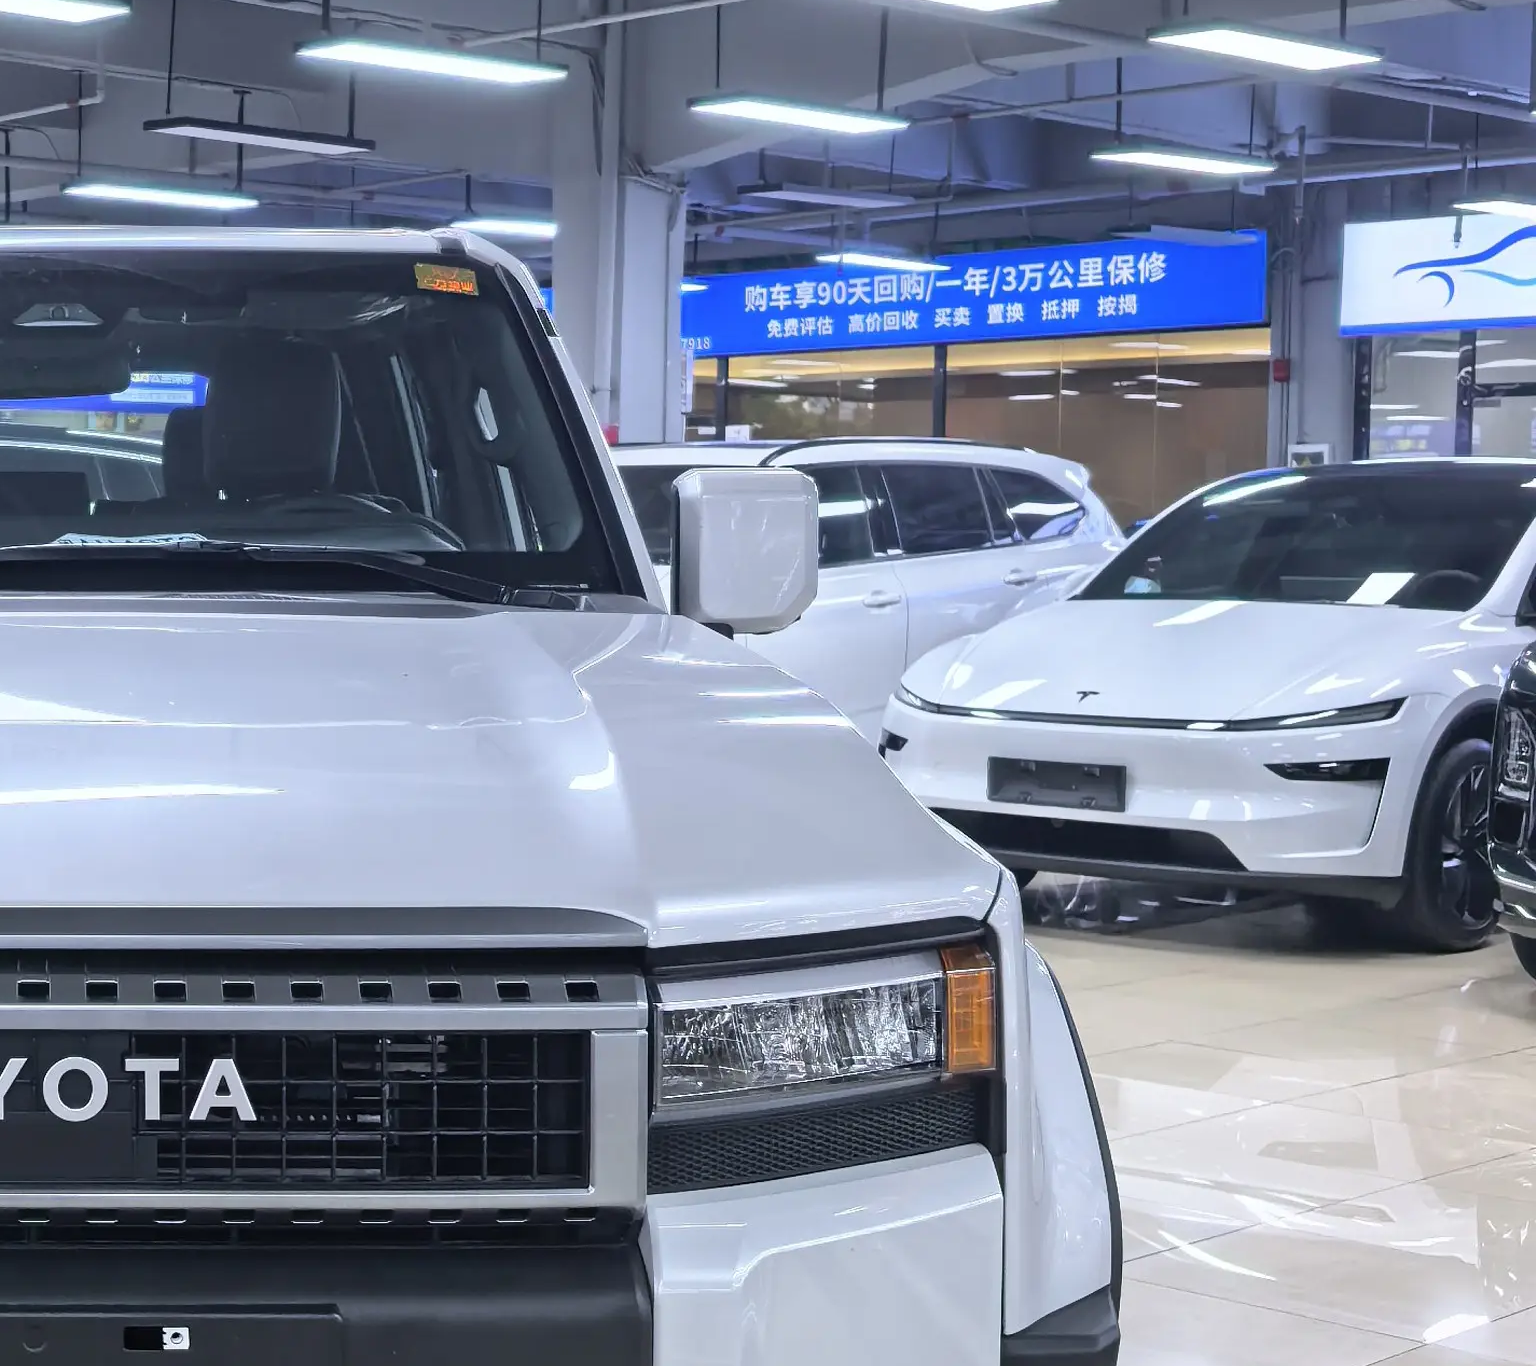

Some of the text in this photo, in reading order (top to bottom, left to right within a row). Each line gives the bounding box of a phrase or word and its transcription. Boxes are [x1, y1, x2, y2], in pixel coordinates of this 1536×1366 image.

[744, 251, 1167, 313] 购车享90天回购/一年/3万公里保修
[766, 294, 1138, 338] 免费评估 高价回收 买卖 置换 抵押 按揭
